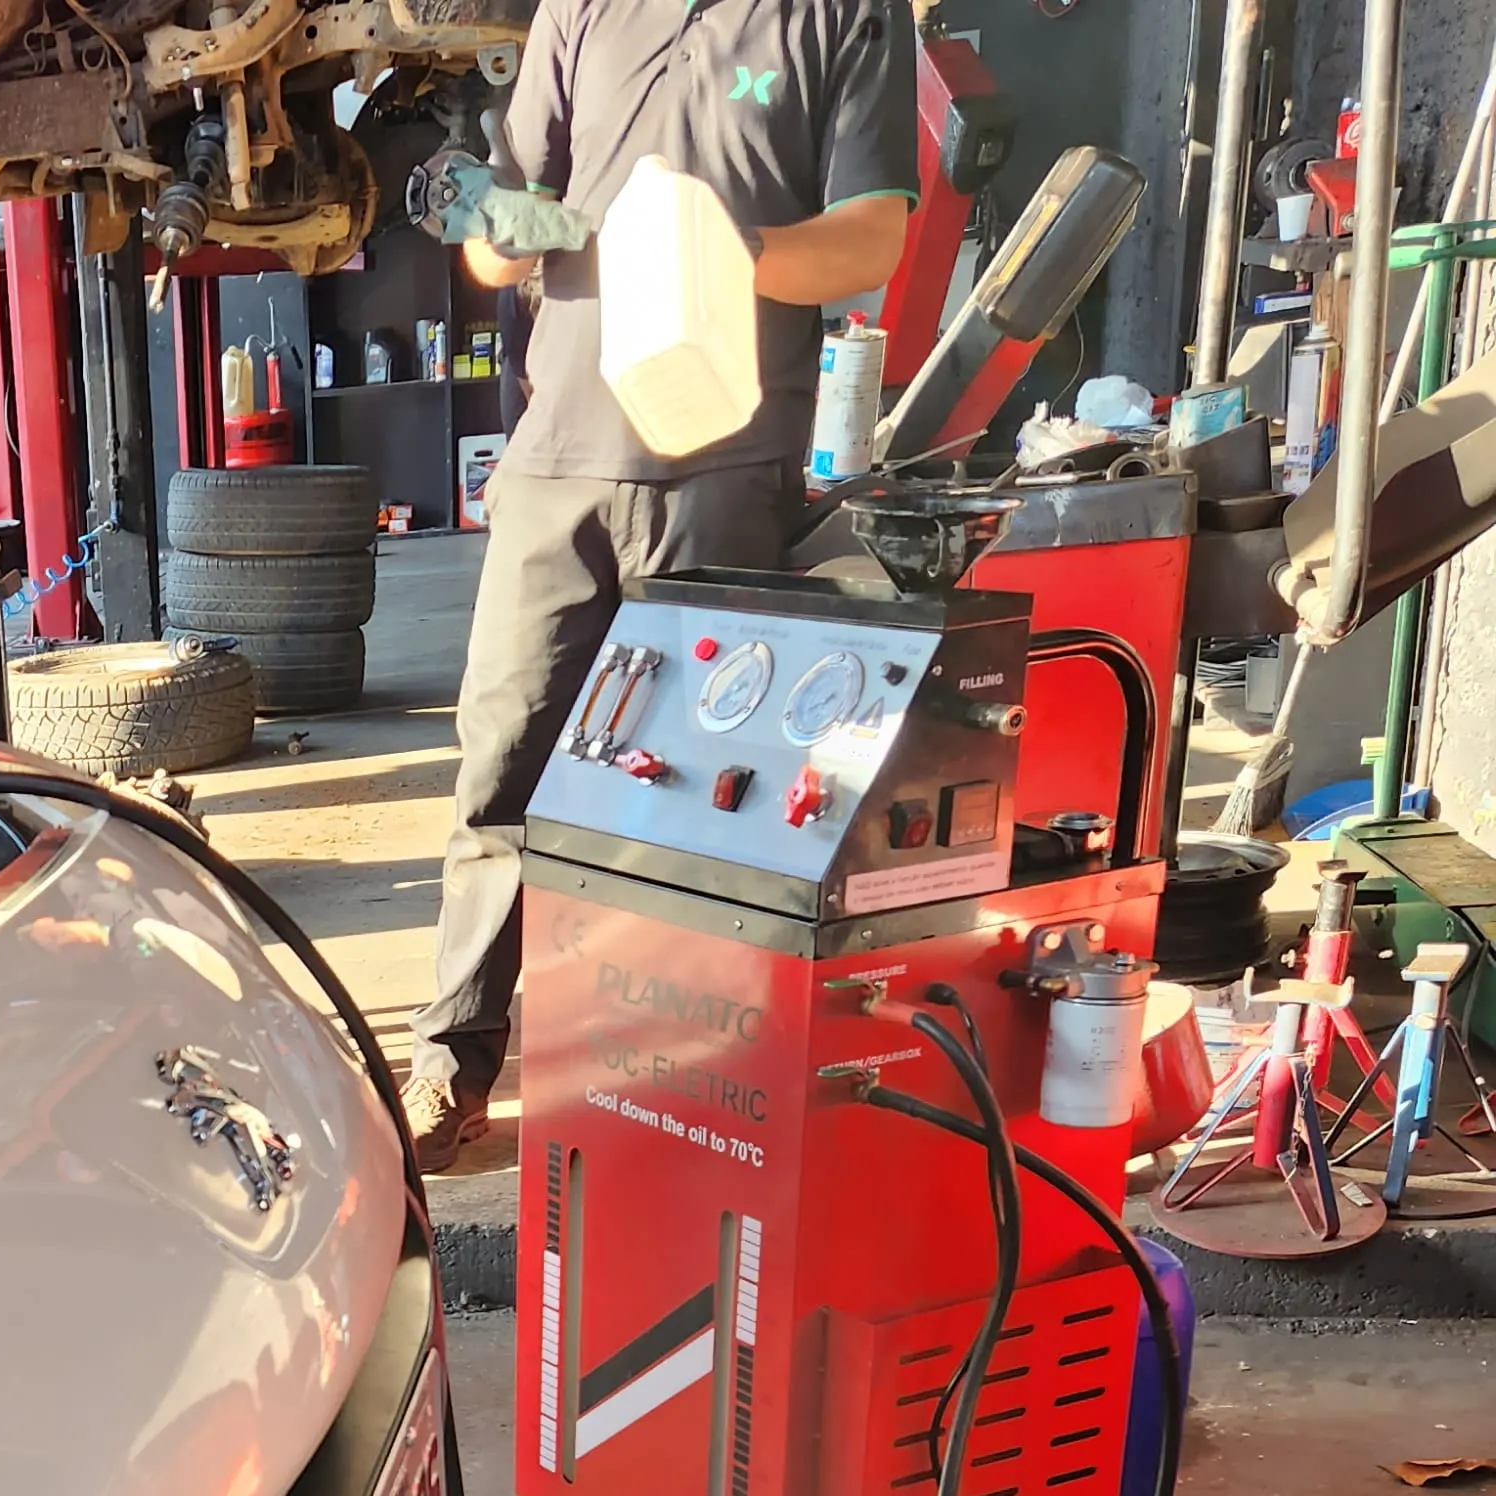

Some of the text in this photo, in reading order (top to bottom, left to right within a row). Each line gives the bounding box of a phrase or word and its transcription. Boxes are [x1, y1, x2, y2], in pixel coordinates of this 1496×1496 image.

[959, 672, 1004, 690] FILLING
[595, 961, 764, 1043] PLANATC
[585, 1084, 765, 1168] Cool down the oil to 70°C
